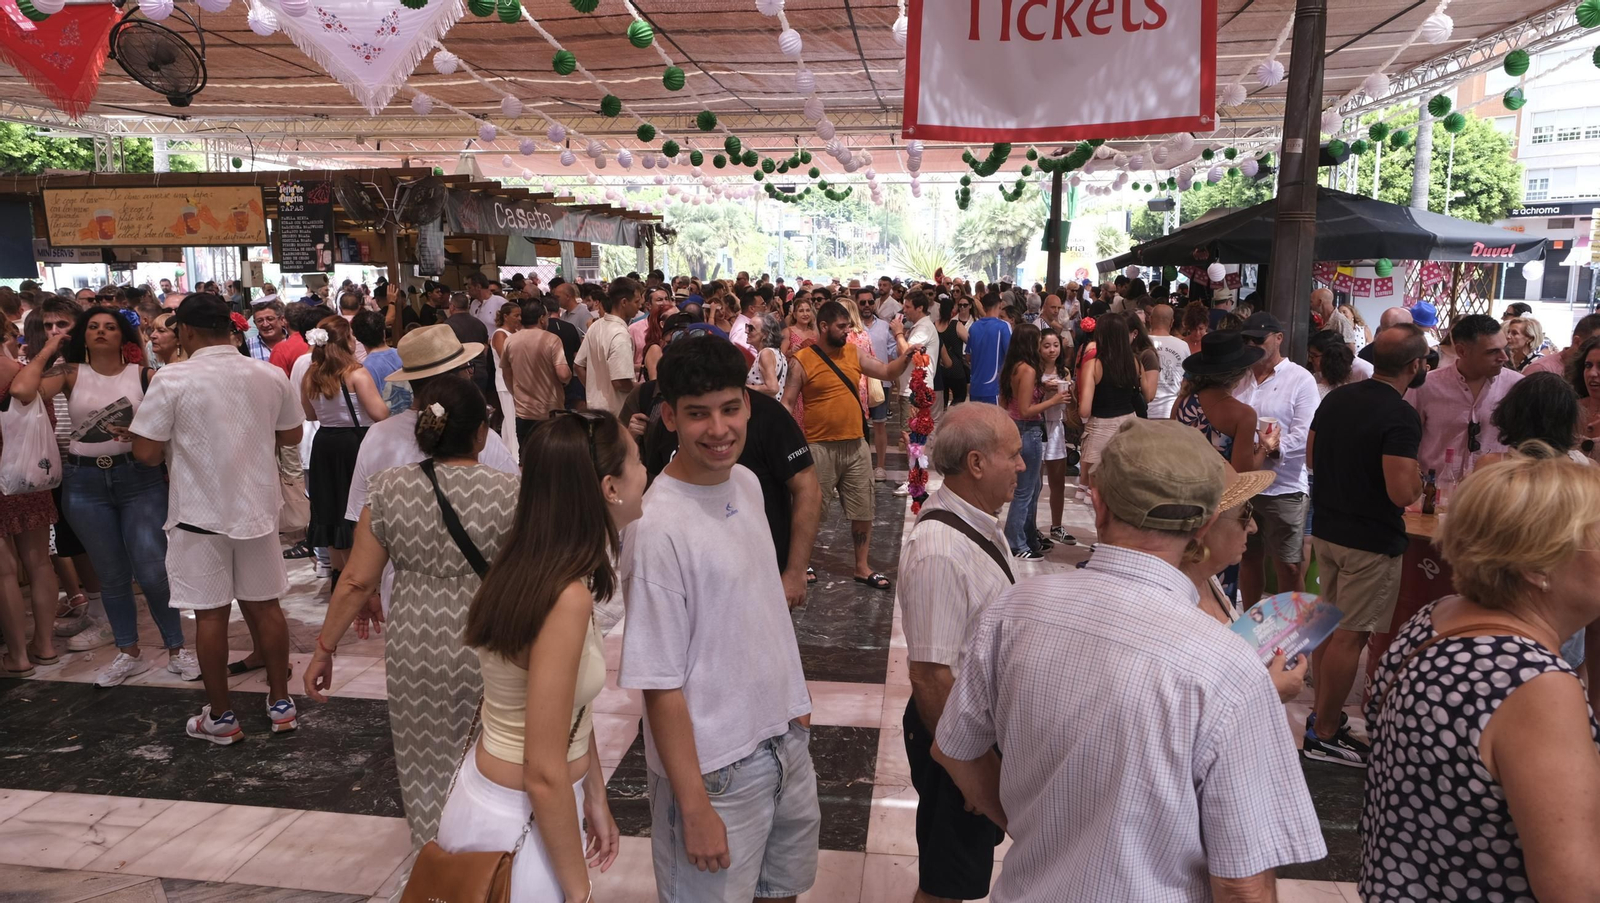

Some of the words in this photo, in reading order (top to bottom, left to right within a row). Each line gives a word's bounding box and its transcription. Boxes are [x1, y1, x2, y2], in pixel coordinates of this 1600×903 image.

[1520, 206, 1560, 215] achroma
[494, 202, 554, 232] Caseta
[37, 249, 51, 257] MINI
[52, 248, 74, 257] SERVIS
[1471, 242, 1516, 258] Duvel
